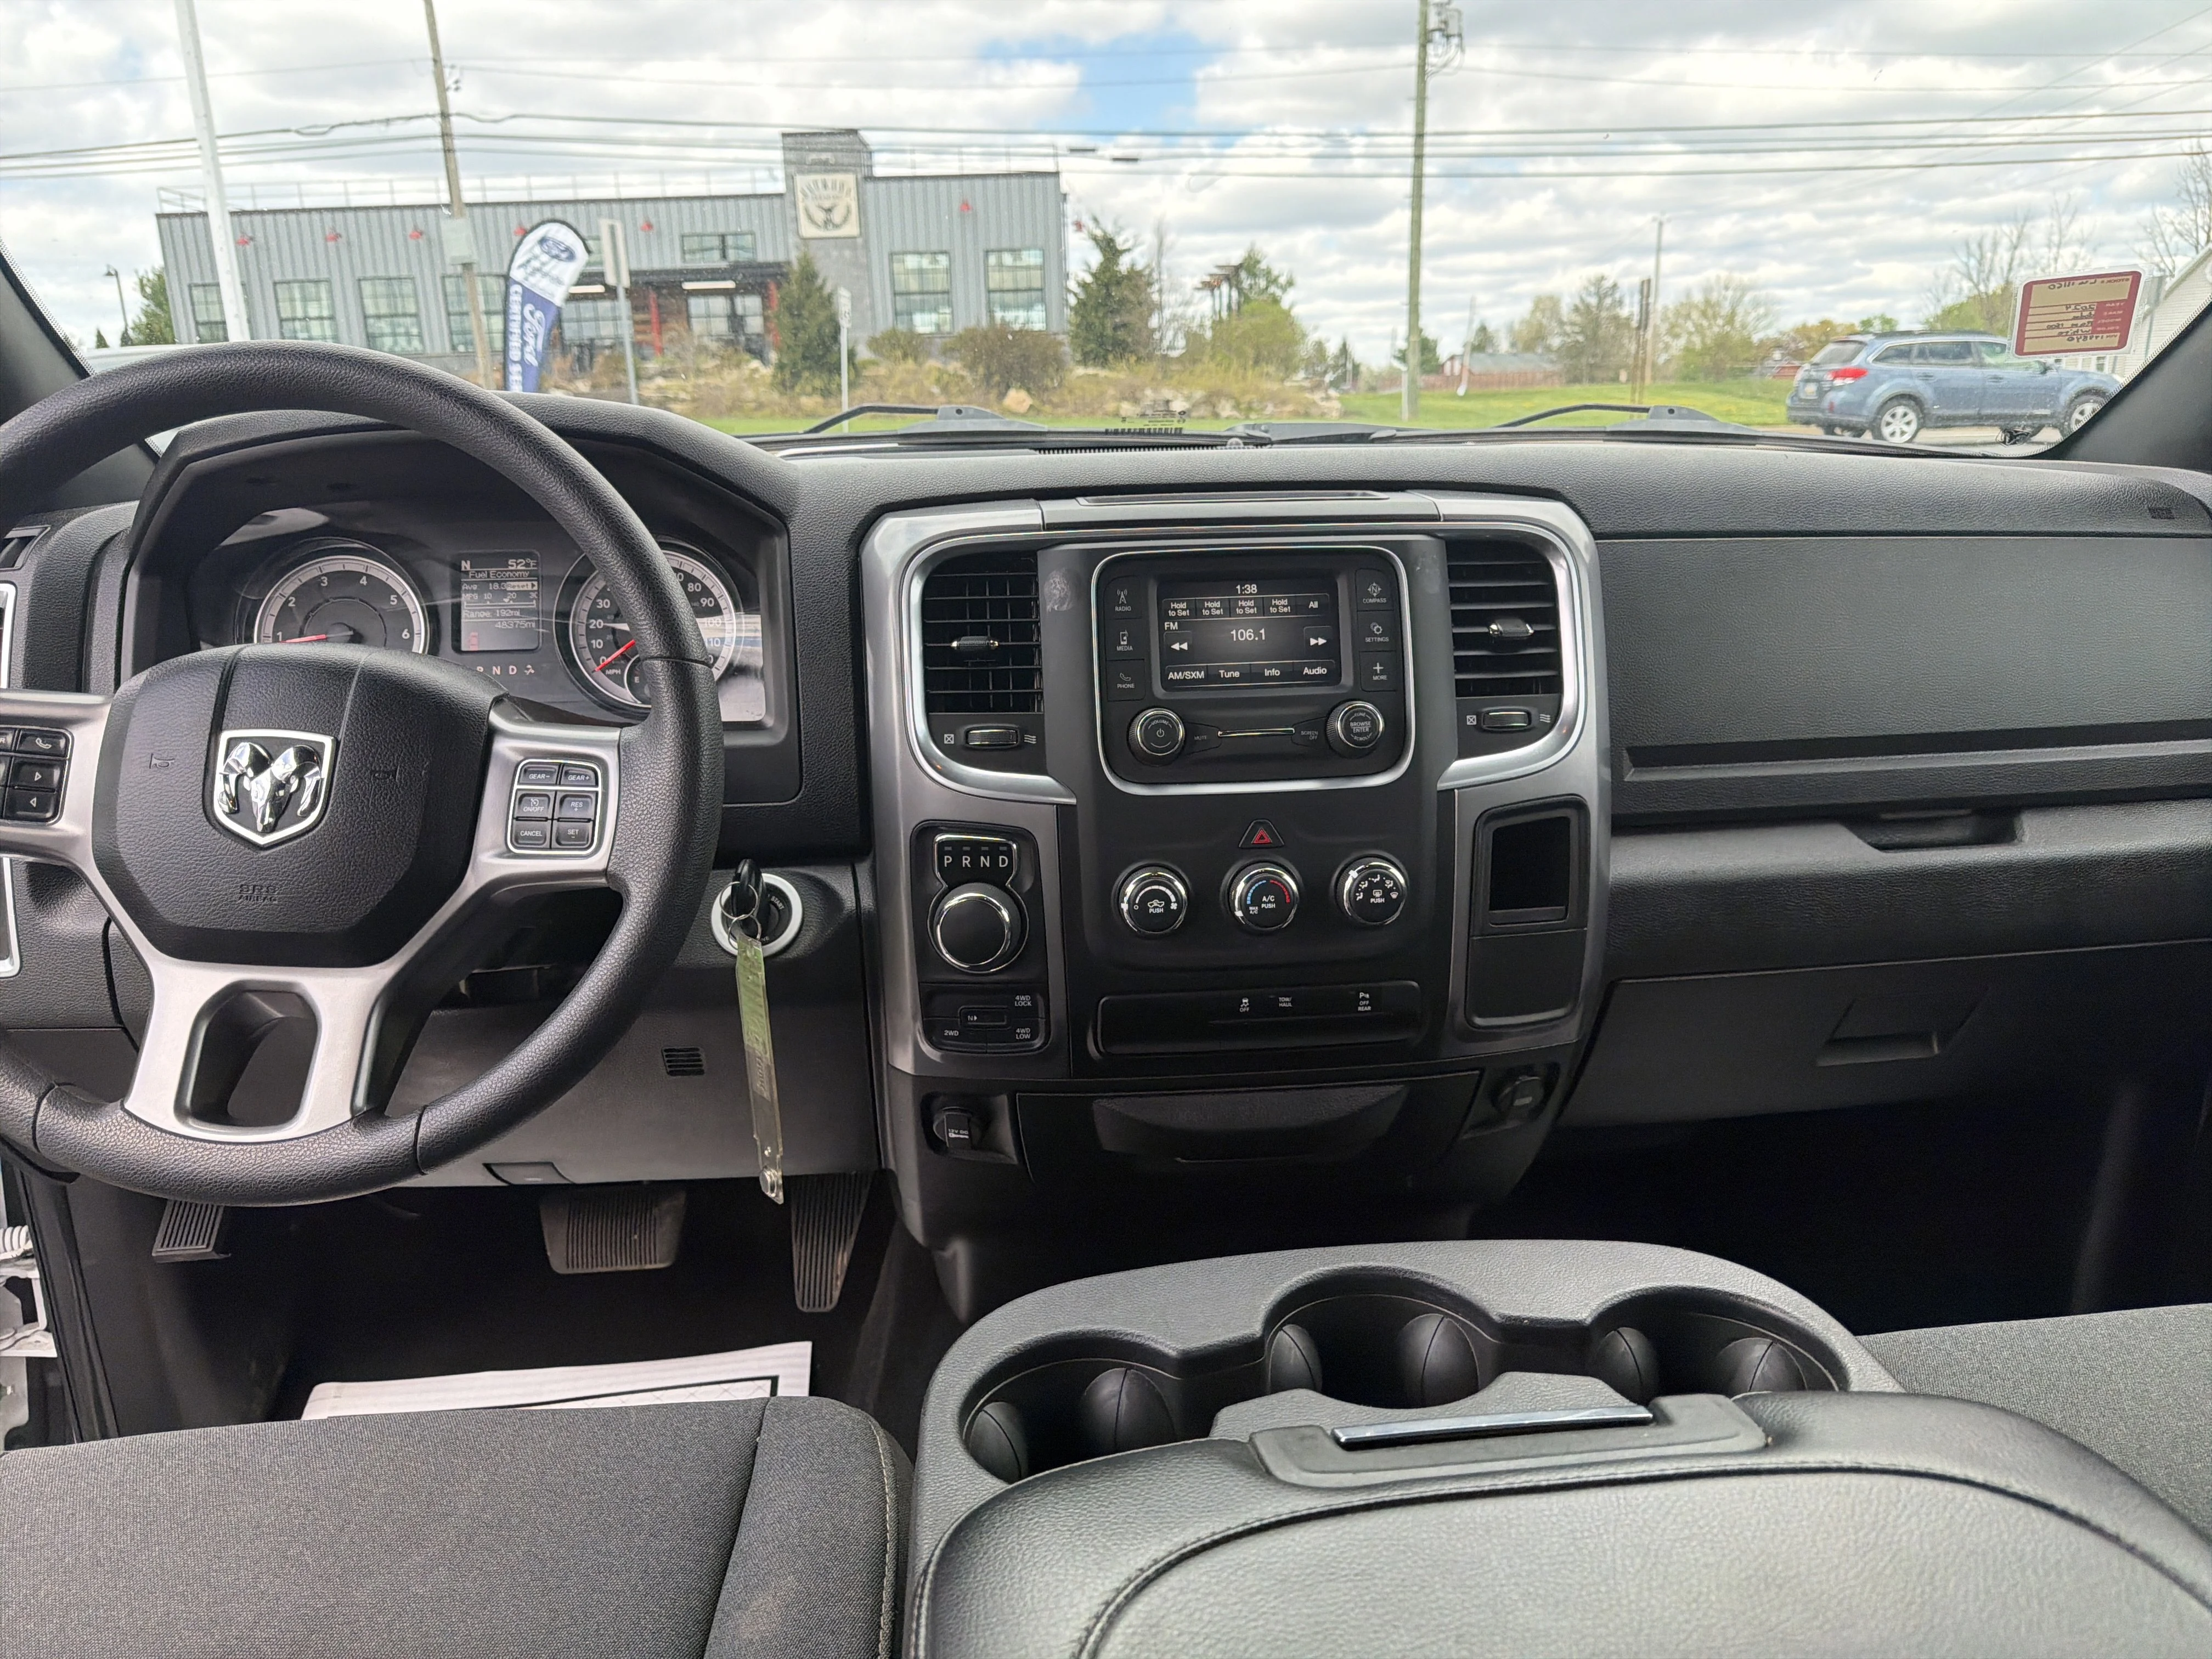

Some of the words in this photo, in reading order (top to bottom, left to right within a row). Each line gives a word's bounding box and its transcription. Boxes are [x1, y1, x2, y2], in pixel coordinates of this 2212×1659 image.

[523, 303, 546, 367] Ford
[461, 560, 471, 571] N
[490, 570, 530, 578] Economy
[320, 577, 328, 586] 3
[359, 577, 367, 585] 4
[687, 583, 702, 592] 80
[1236, 584, 1257, 594] 1:38
[288, 597, 296, 607] 2
[390, 595, 398, 605] 5
[596, 599, 611, 608] 30
[700, 597, 714, 607] 90
[1205, 600, 1221, 608] Hold
[1238, 599, 1254, 607] Hold
[1272, 598, 1288, 606] Hold
[1308, 600, 1318, 609] All
[1170, 601, 1187, 610] Hold
[589, 619, 603, 629] 20
[1164, 622, 1178, 630] FM
[402, 629, 410, 639] 6
[1230, 629, 1266, 641] 106.1
[591, 639, 603, 648] 10
[492, 665, 501, 675] N
[509, 665, 517, 675] D
[1168, 669, 1204, 680] AM/SXM
[1218, 669, 1240, 678] Tune
[1265, 668, 1280, 676] Info
[1303, 666, 1327, 675] Audio
[945, 856, 952, 867] P
[963, 856, 971, 867] R
[981, 856, 989, 867] N
[999, 856, 1008, 867] D
[770, 895, 785, 910] START
